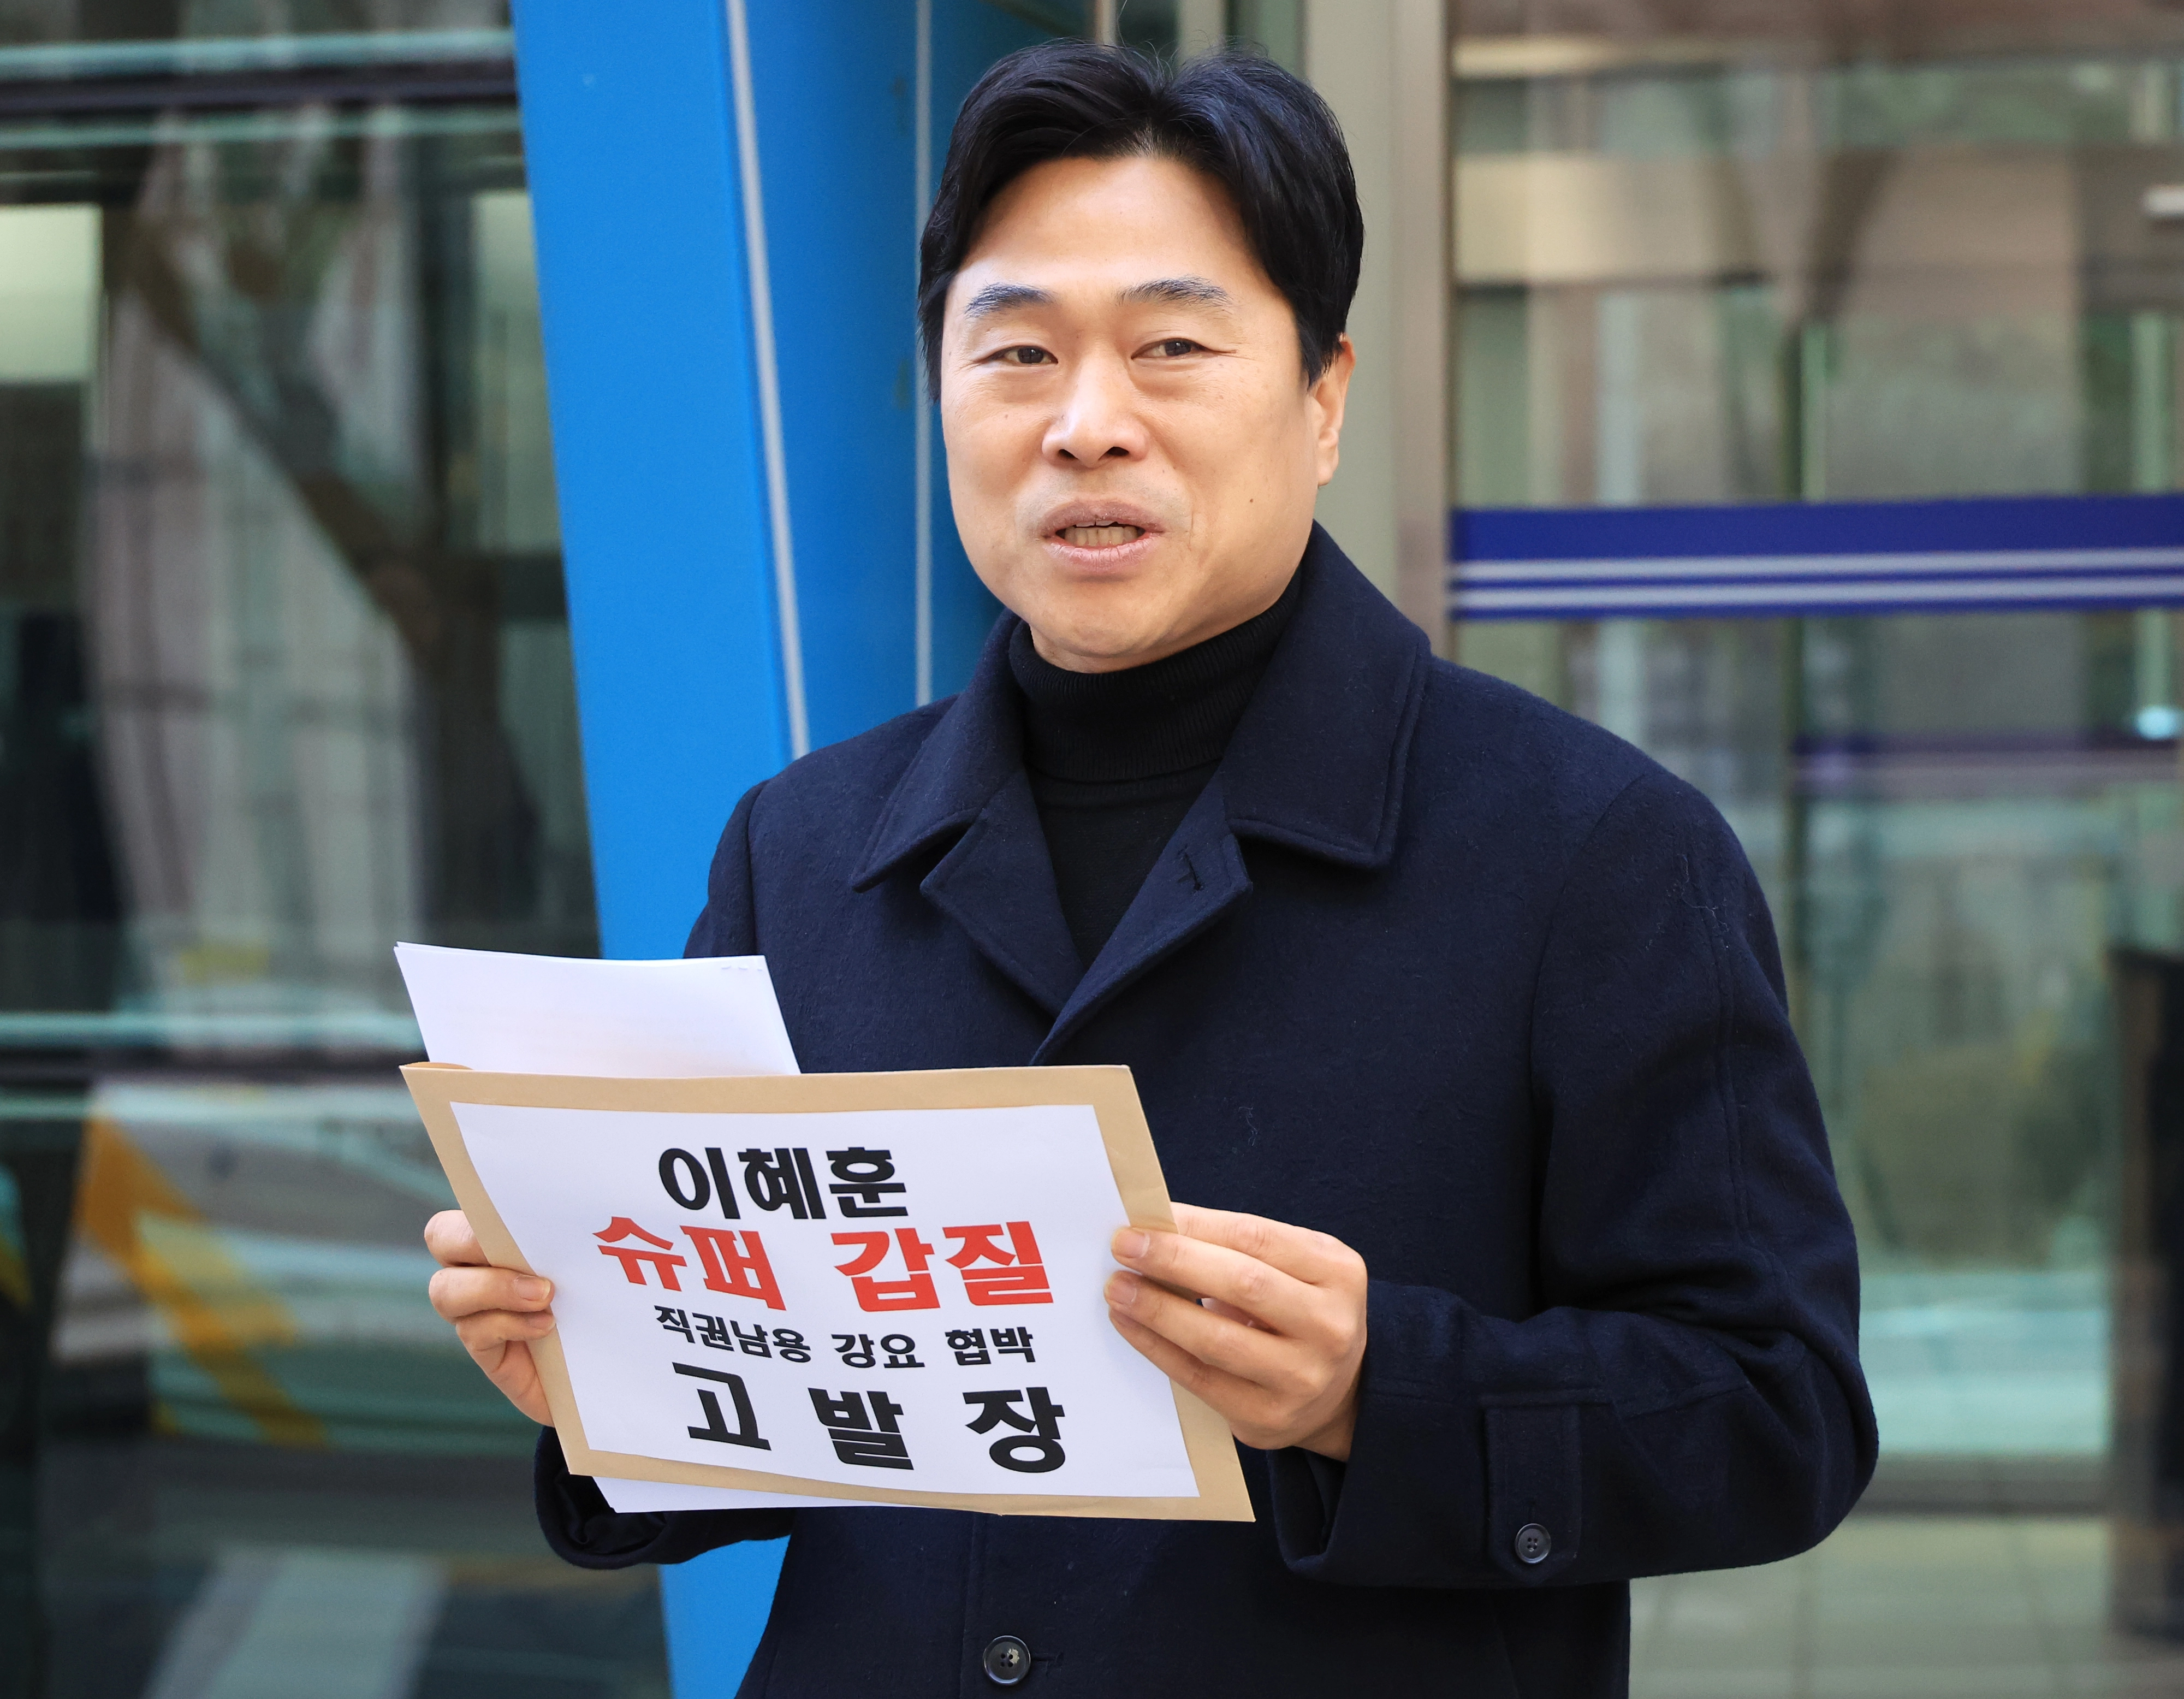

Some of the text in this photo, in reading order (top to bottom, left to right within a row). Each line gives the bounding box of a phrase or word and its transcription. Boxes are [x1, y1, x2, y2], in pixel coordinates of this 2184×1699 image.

[658, 1146, 909, 1220] 이혜훈
[592, 1216, 1053, 1312] 슈퍼 갑질
[654, 1305, 1036, 1369] 직권남용 강요 협박
